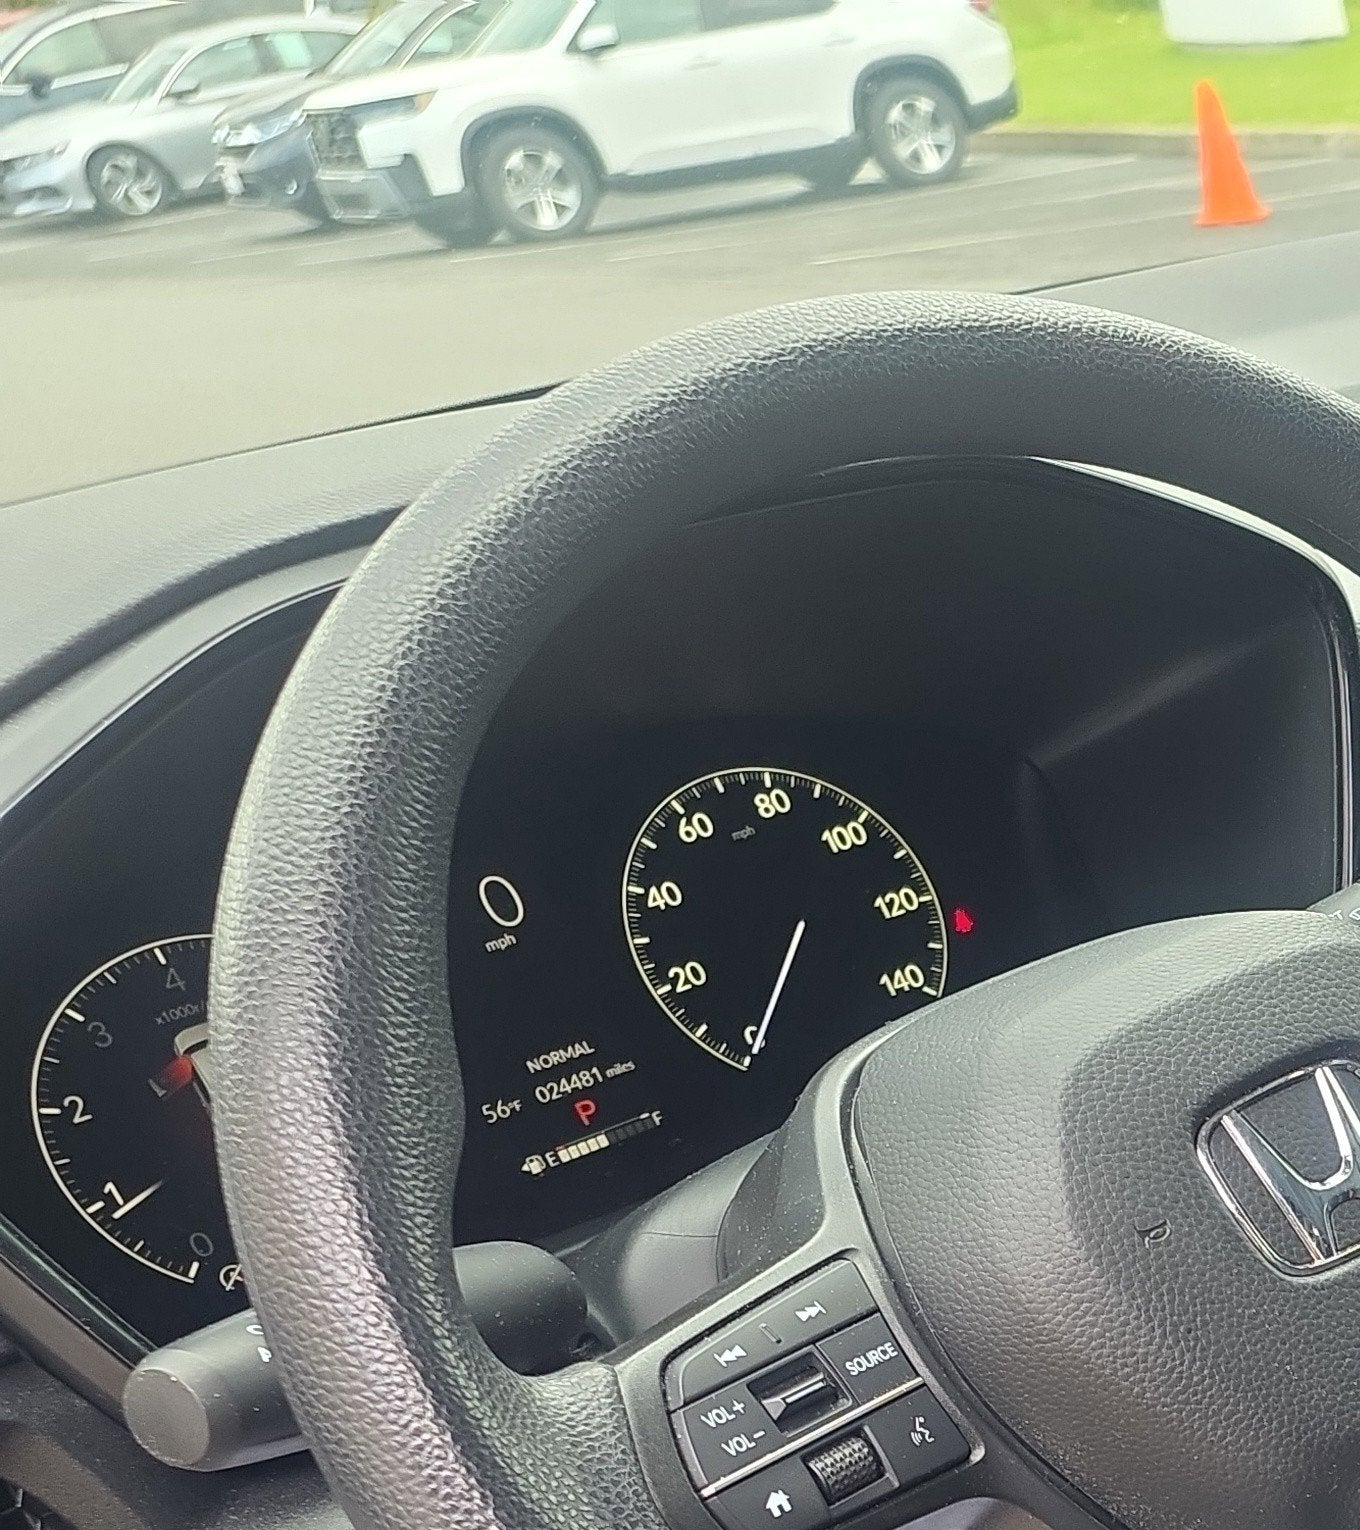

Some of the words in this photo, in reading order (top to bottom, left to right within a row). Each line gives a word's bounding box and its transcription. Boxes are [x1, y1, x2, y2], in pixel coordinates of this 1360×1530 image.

[754, 788, 791, 819] 80
[678, 812, 714, 843] 60
[821, 821, 867, 853] 100
[479, 875, 524, 927] 0
[647, 881, 682, 911] 40
[874, 887, 919, 919] 120
[485, 932, 517, 953] mph
[165, 967, 187, 991] 4
[667, 961, 707, 993] 20
[879, 964, 925, 997] 140
[86, 1021, 113, 1048] 3
[525, 1040, 596, 1074] NORMAL
[534, 1066, 604, 1104] 024481
[604, 1060, 636, 1079] miles
[62, 1094, 93, 1124] 2
[573, 1099, 597, 1126] P
[651, 1110, 664, 1127] F
[544, 1150, 559, 1168] E
[103, 1181, 124, 1206] 1
[190, 1231, 213, 1257] 0
[845, 1342, 898, 1376] SOURCE
[700, 1399, 746, 1429] VOL+
